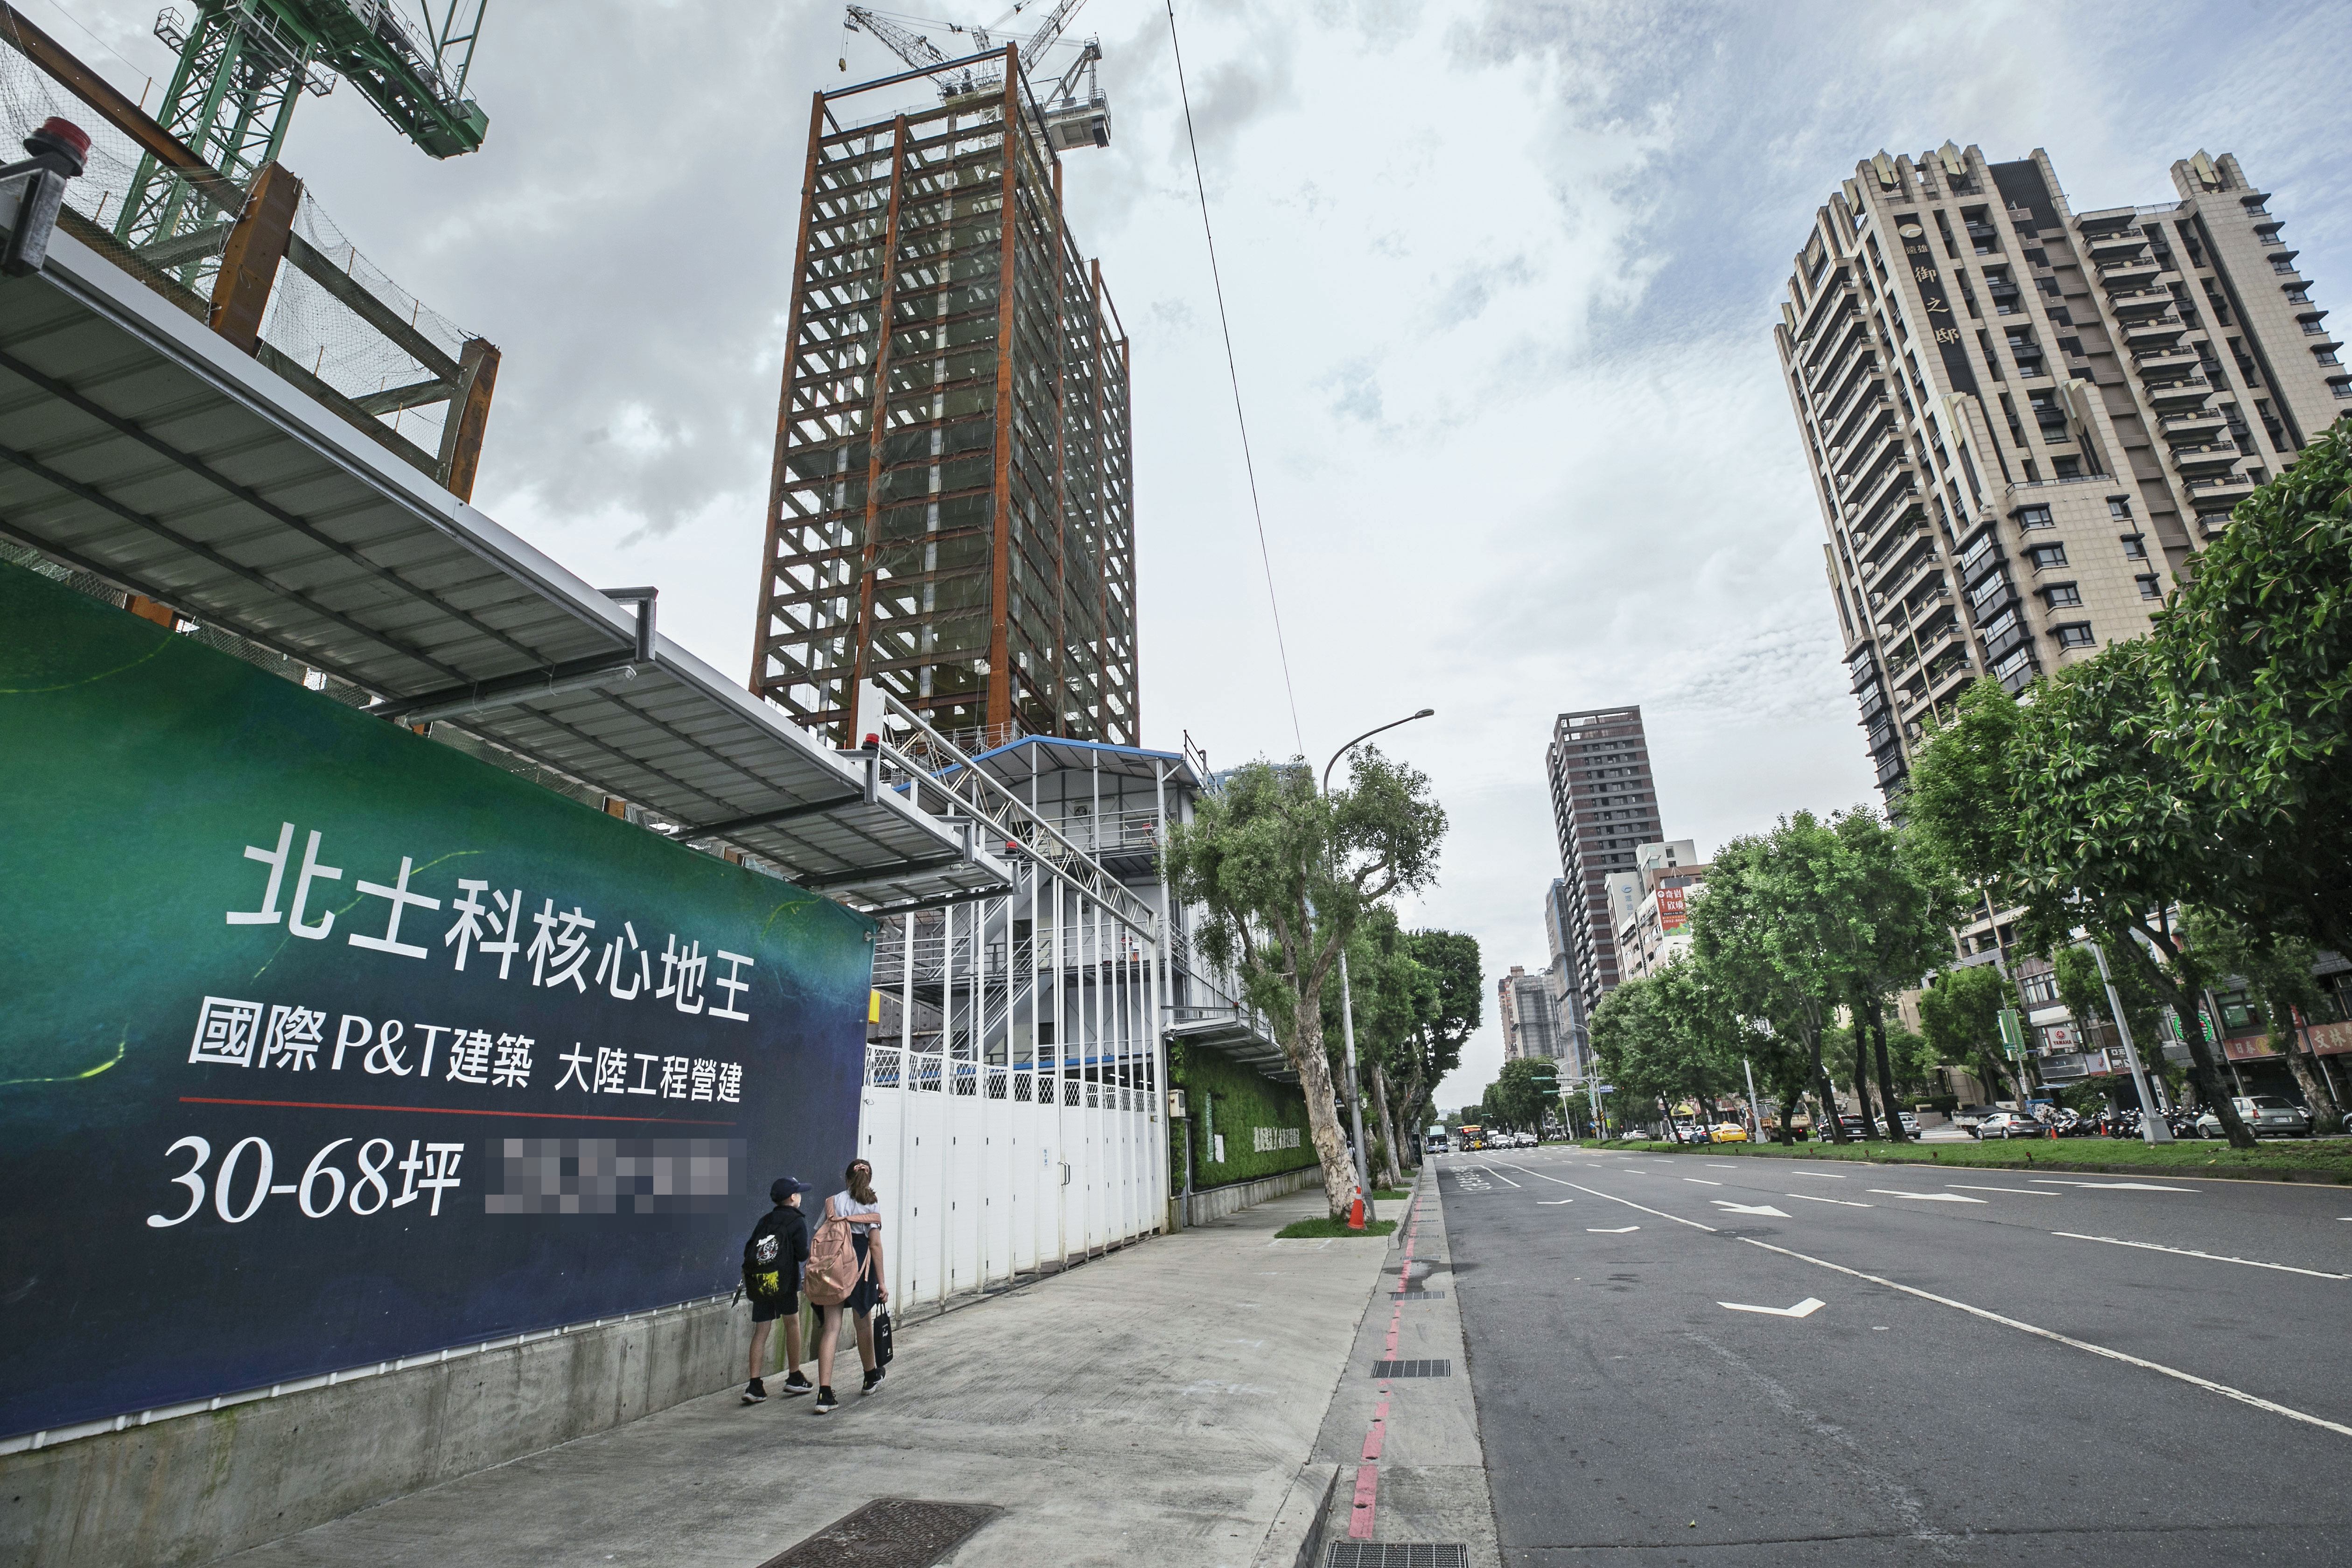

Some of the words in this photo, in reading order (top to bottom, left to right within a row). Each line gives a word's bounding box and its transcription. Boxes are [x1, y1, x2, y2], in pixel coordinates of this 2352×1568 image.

[1906, 245, 1929, 254] 遠雄
[1915, 266, 1959, 344] 御之邸
[1666, 889, 1681, 899] 奇岩
[1667, 900, 1684, 910] 欣境
[226, 822, 754, 1022] 北士科核心地王
[188, 995, 535, 1089] 國際P&T建築
[554, 1042, 743, 1104] 大陸工程營建
[2315, 1028, 2346, 1049] 文林
[147, 1135, 465, 1228] 30-68坪
